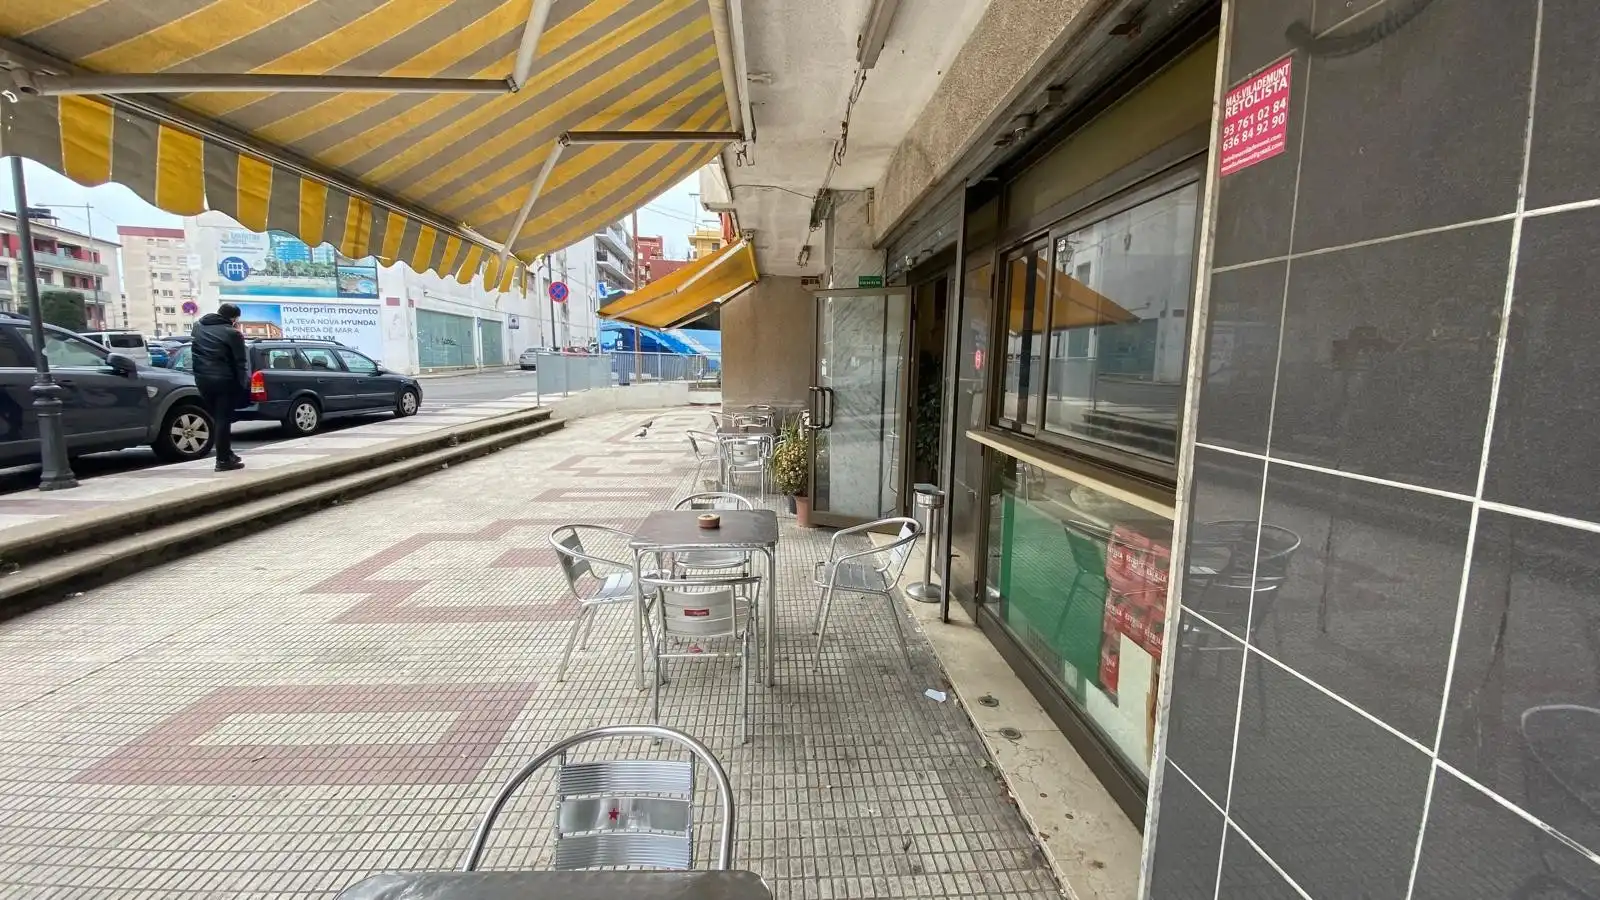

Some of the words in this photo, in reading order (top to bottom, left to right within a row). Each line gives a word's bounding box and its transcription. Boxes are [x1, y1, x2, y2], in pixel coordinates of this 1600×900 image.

[1223, 123, 1235, 138] 93
[1238, 113, 1254, 132] 761
[1257, 105, 1270, 121] 02
[1272, 97, 1286, 114] 84
[1225, 76, 1288, 120] RETOLISTA
[1223, 134, 1240, 152] 636
[1241, 127, 1254, 142] 84
[1256, 120, 1269, 136] 92
[1272, 112, 1285, 129] 90
[283, 305, 336, 315] motorprim
